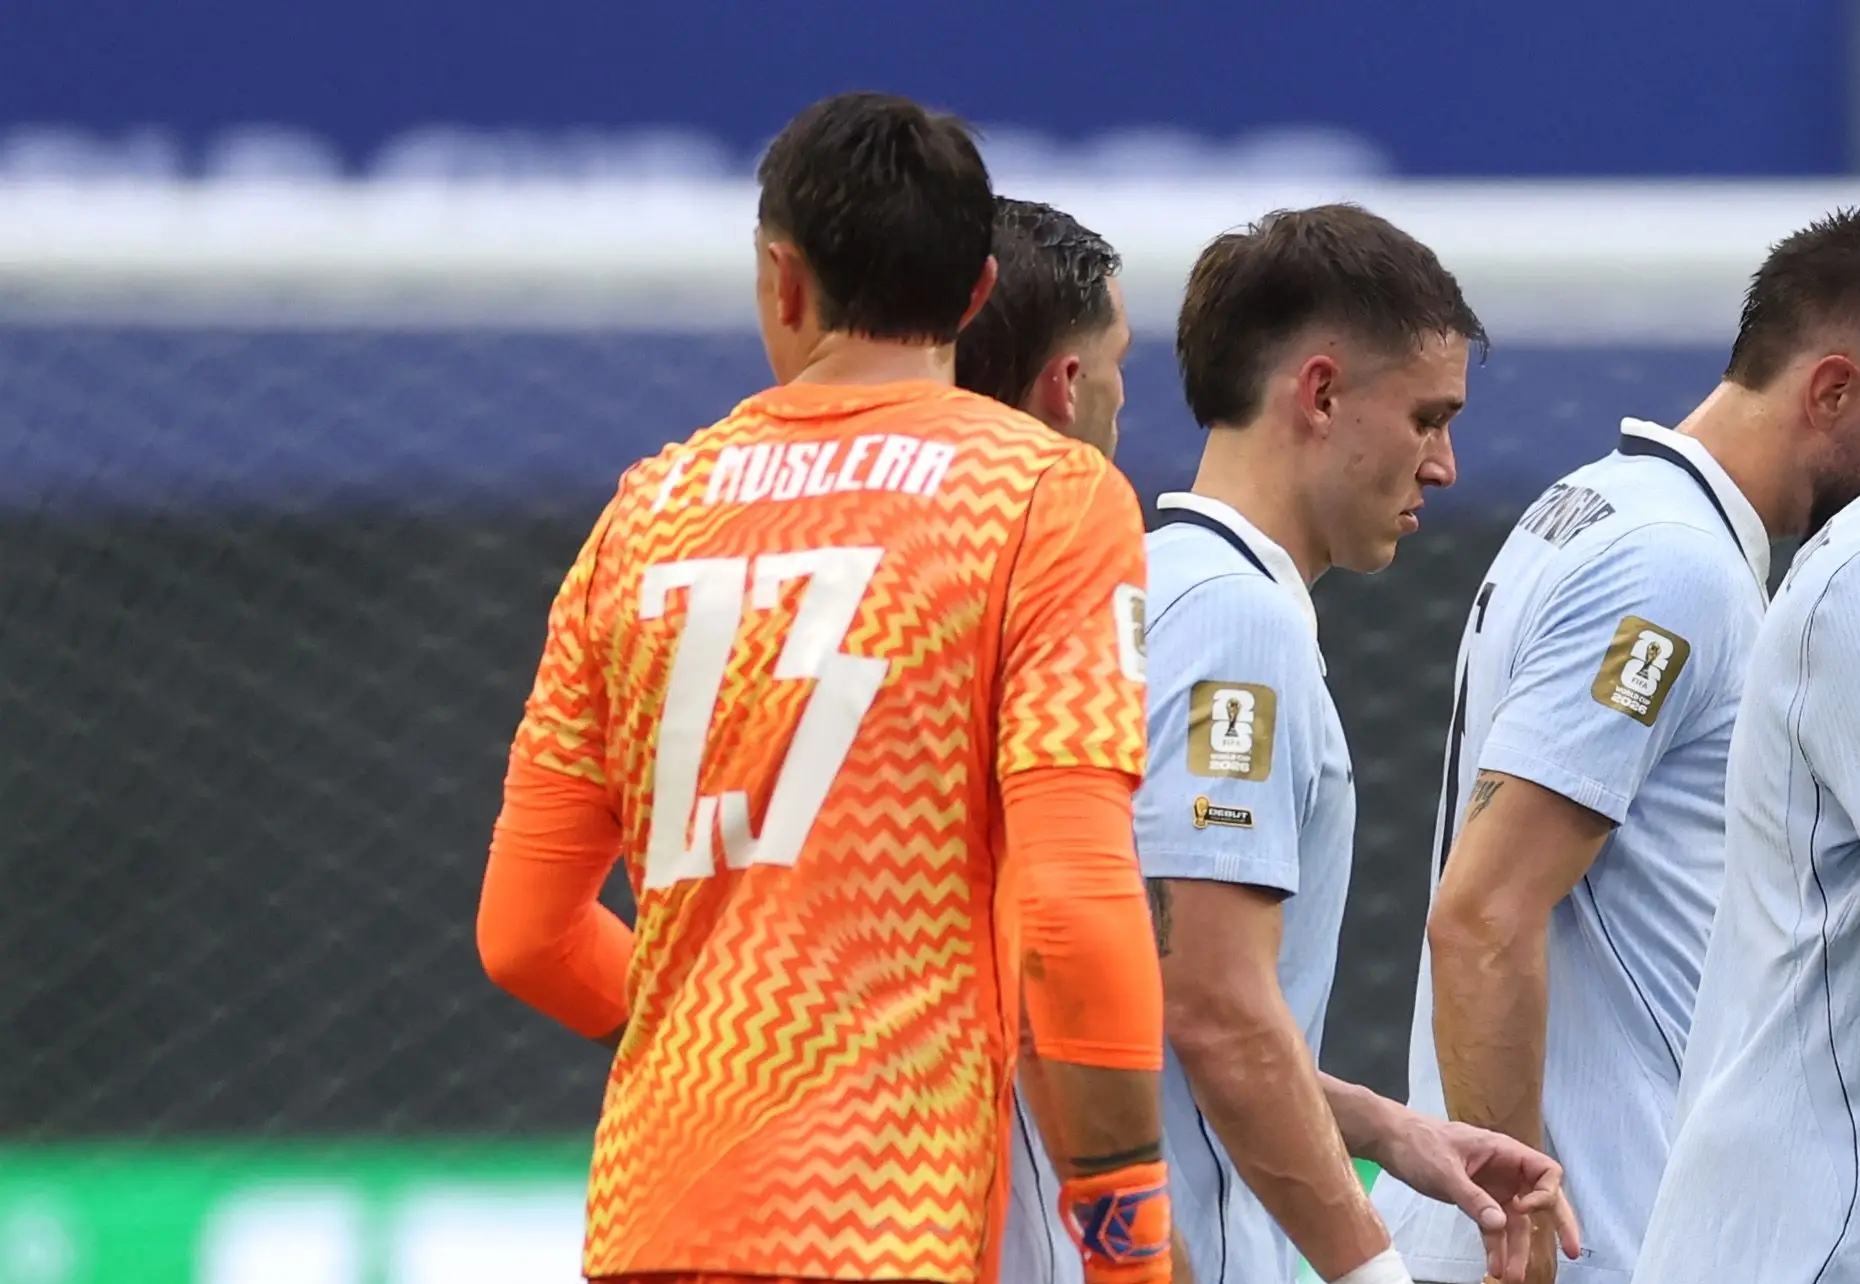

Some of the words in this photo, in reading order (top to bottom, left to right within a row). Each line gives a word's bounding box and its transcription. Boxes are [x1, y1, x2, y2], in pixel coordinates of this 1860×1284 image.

[702, 433, 956, 504] MUSLERA
[1631, 677, 1648, 690] FIFA
[1610, 692, 1648, 715] 2026
[1208, 808, 1248, 819] DEBUT
